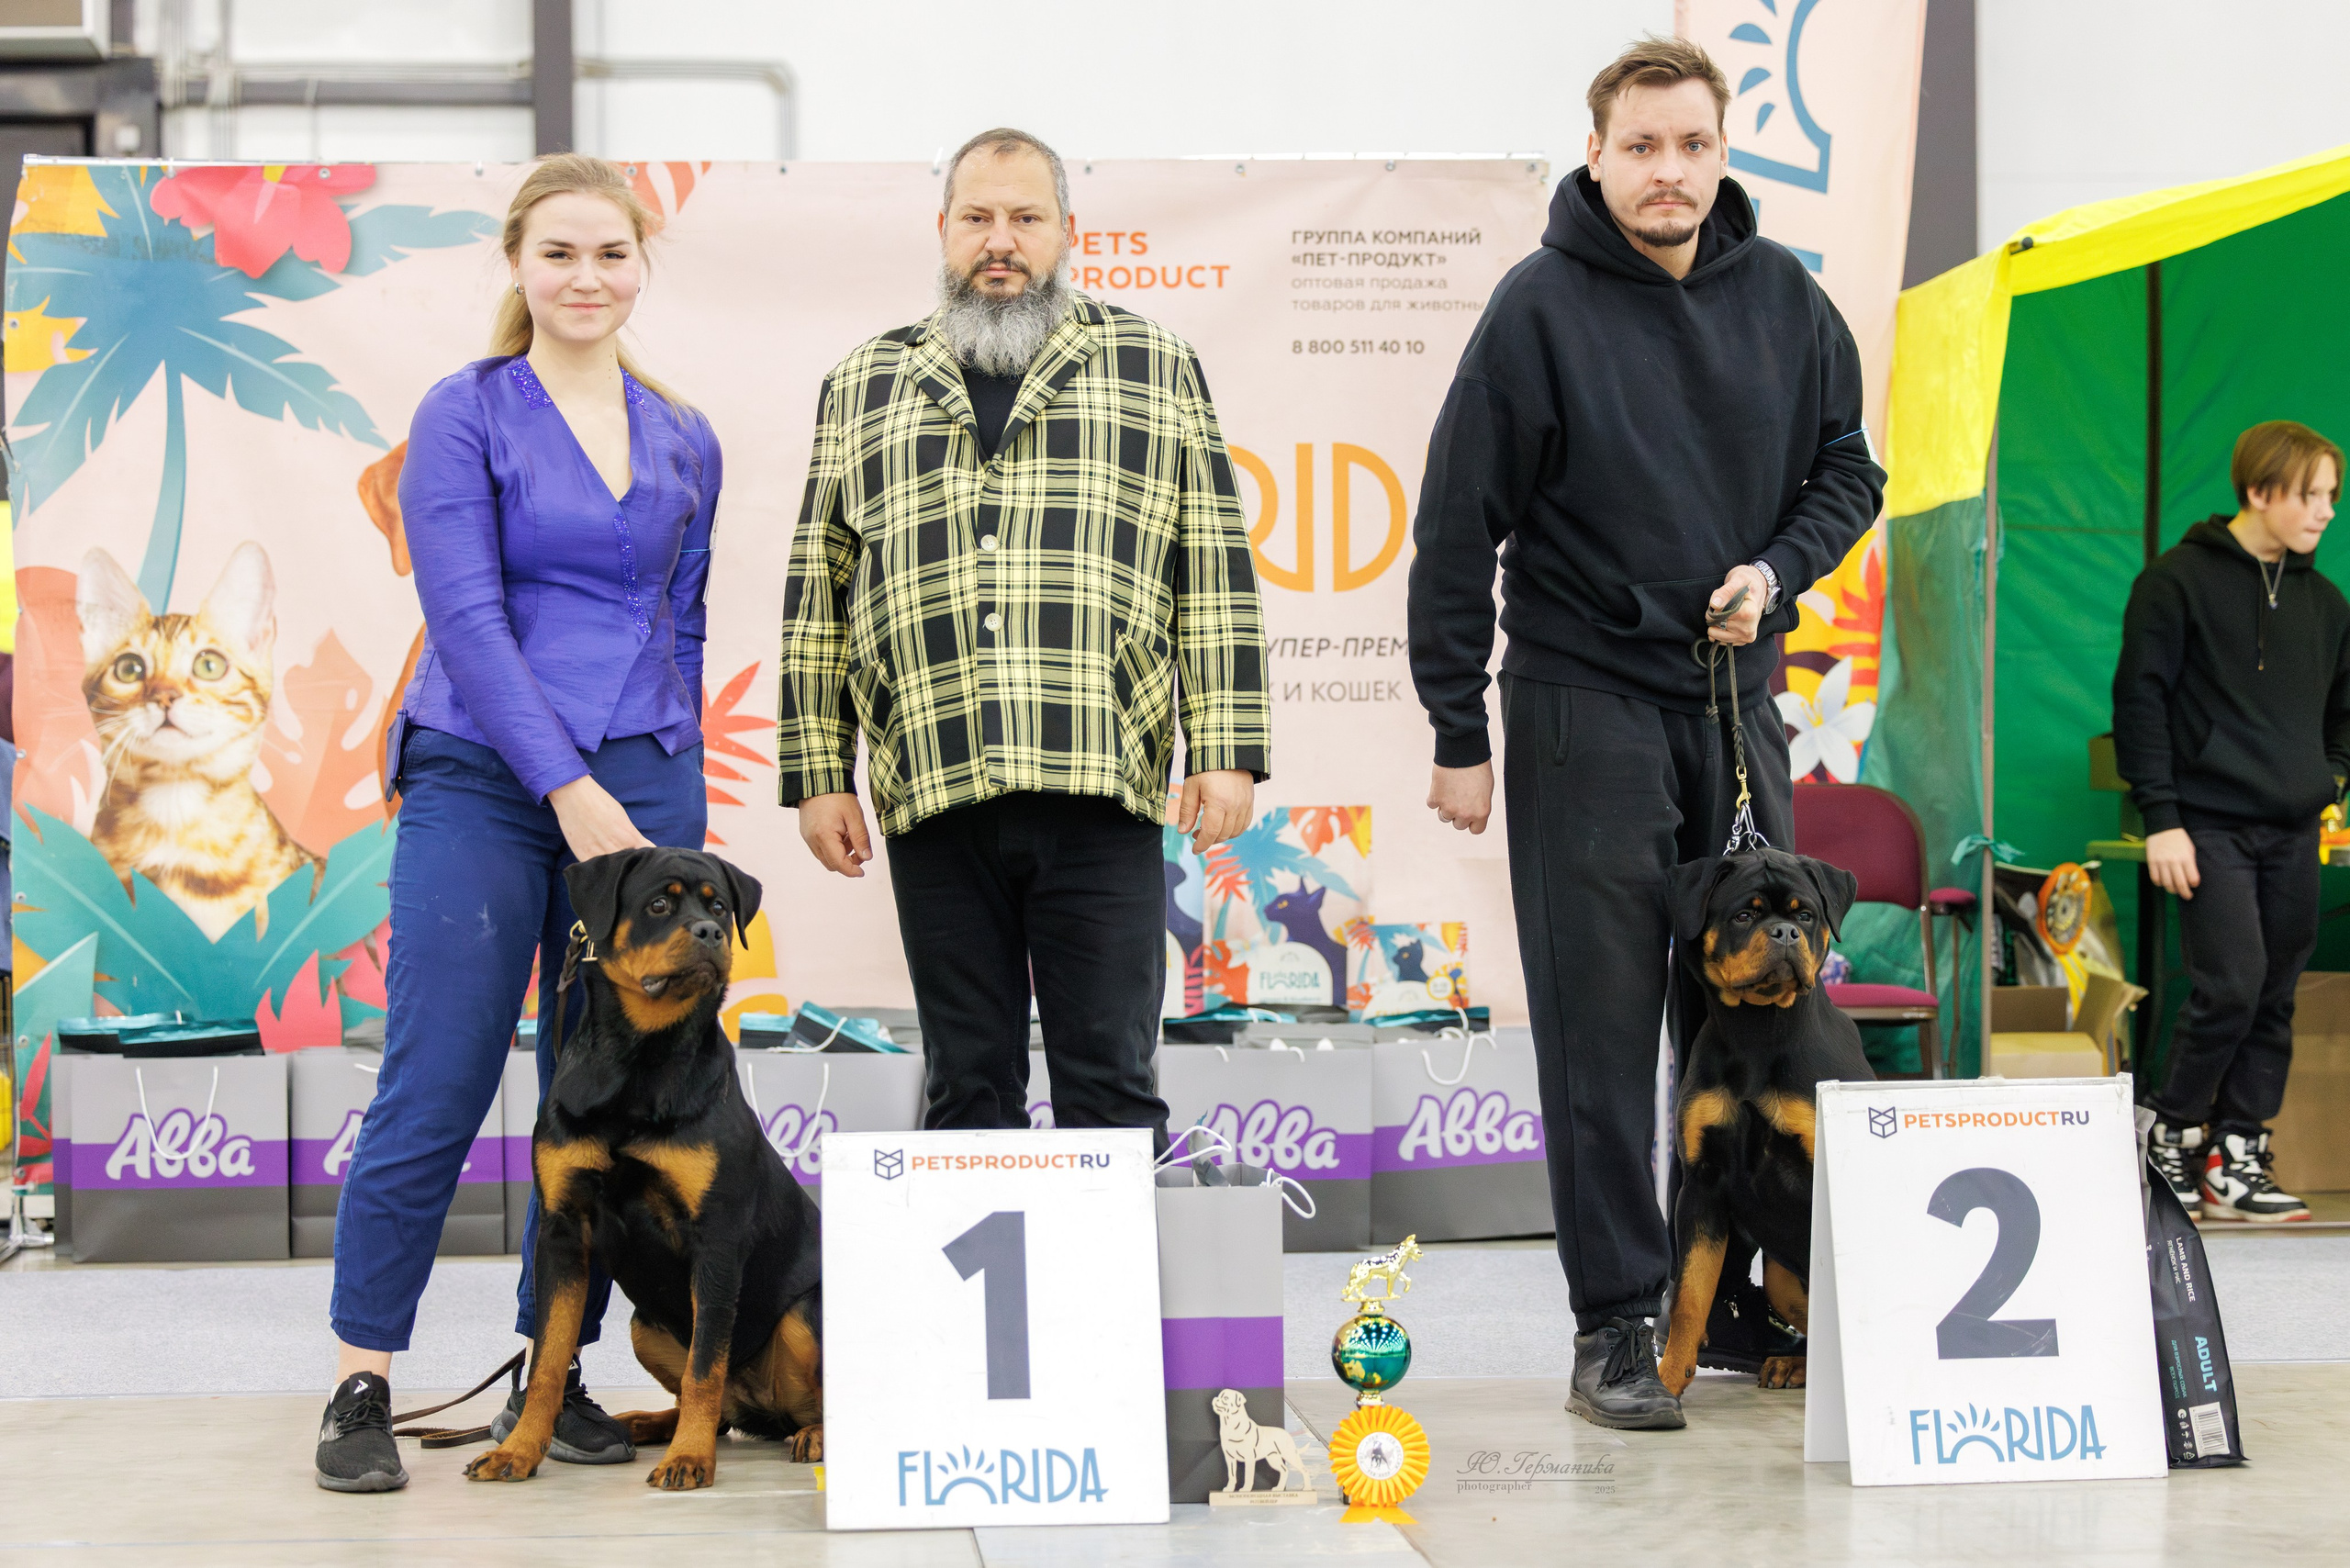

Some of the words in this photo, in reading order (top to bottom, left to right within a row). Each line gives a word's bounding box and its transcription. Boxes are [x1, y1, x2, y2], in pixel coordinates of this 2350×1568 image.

[1292, 230, 1366, 245] ГРУППА
[1372, 228, 1482, 245] КОМПАНИЙ
[1292, 252, 1447, 268] «ПЕТ-ПРОДУКТ»
[1291, 277, 1365, 290] оптовая
[1371, 277, 1448, 292] продажа
[1292, 299, 1365, 313] товаров
[1370, 300, 1402, 312] для
[1292, 341, 1303, 354] 8
[1308, 341, 1345, 354] 800
[1350, 341, 1373, 354] 511
[1379, 341, 1401, 354] 40
[1406, 341, 1425, 354] 10
[1284, 682, 1303, 702] И
[1312, 681, 1402, 702] КОШЕК
[2177, 1237, 2187, 1261] LAMB
[1927, 1167, 2059, 1360] 2
[2181, 1262, 2191, 1281] AND
[2186, 1282, 2196, 1303] RICE
[942, 1211, 1031, 1400] 1
[2195, 1337, 2218, 1392] ADULT
[1909, 1402, 2108, 1465] FLORIDA
[898, 1444, 1109, 1506] FLORIDA
